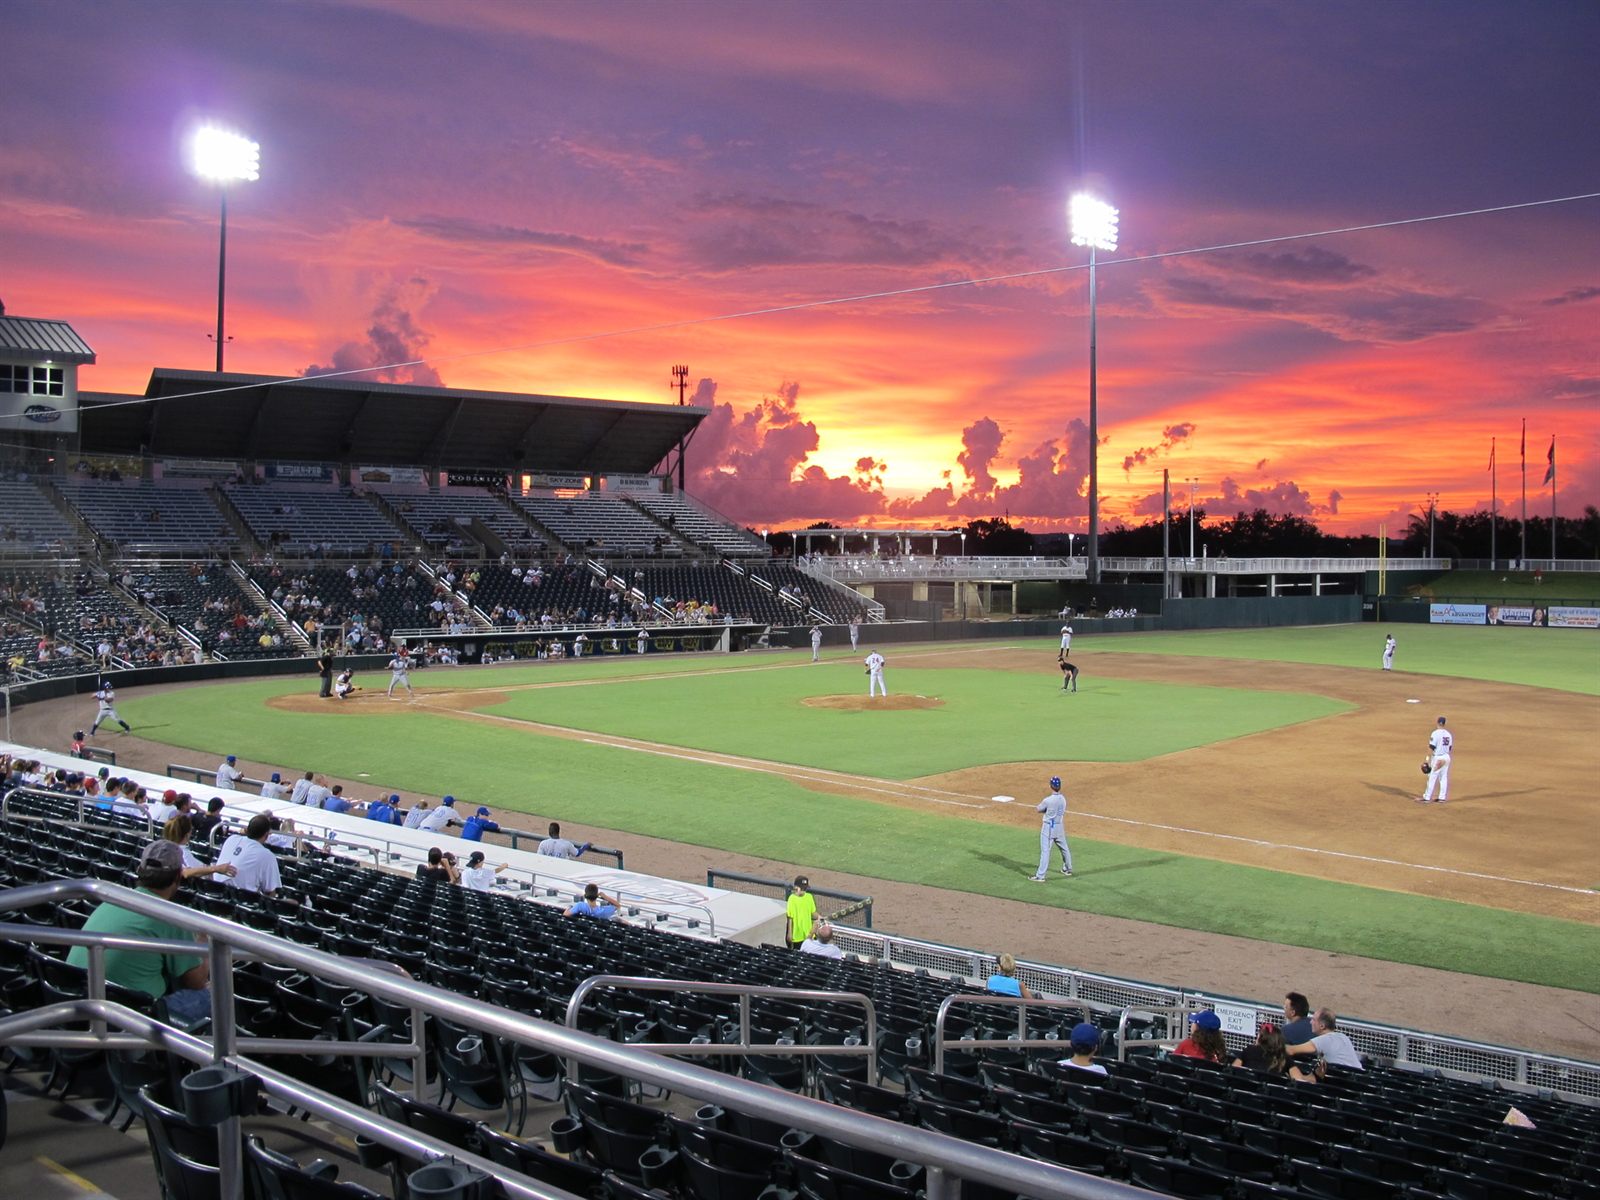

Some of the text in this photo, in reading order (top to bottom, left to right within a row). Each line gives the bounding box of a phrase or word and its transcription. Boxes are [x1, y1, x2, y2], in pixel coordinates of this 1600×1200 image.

[1502, 608, 1531, 616] Martin
[1216, 1007, 1255, 1020] EMERGENCY
[1227, 1016, 1243, 1025] EXIT
[1227, 1023, 1243, 1031] ONLY
